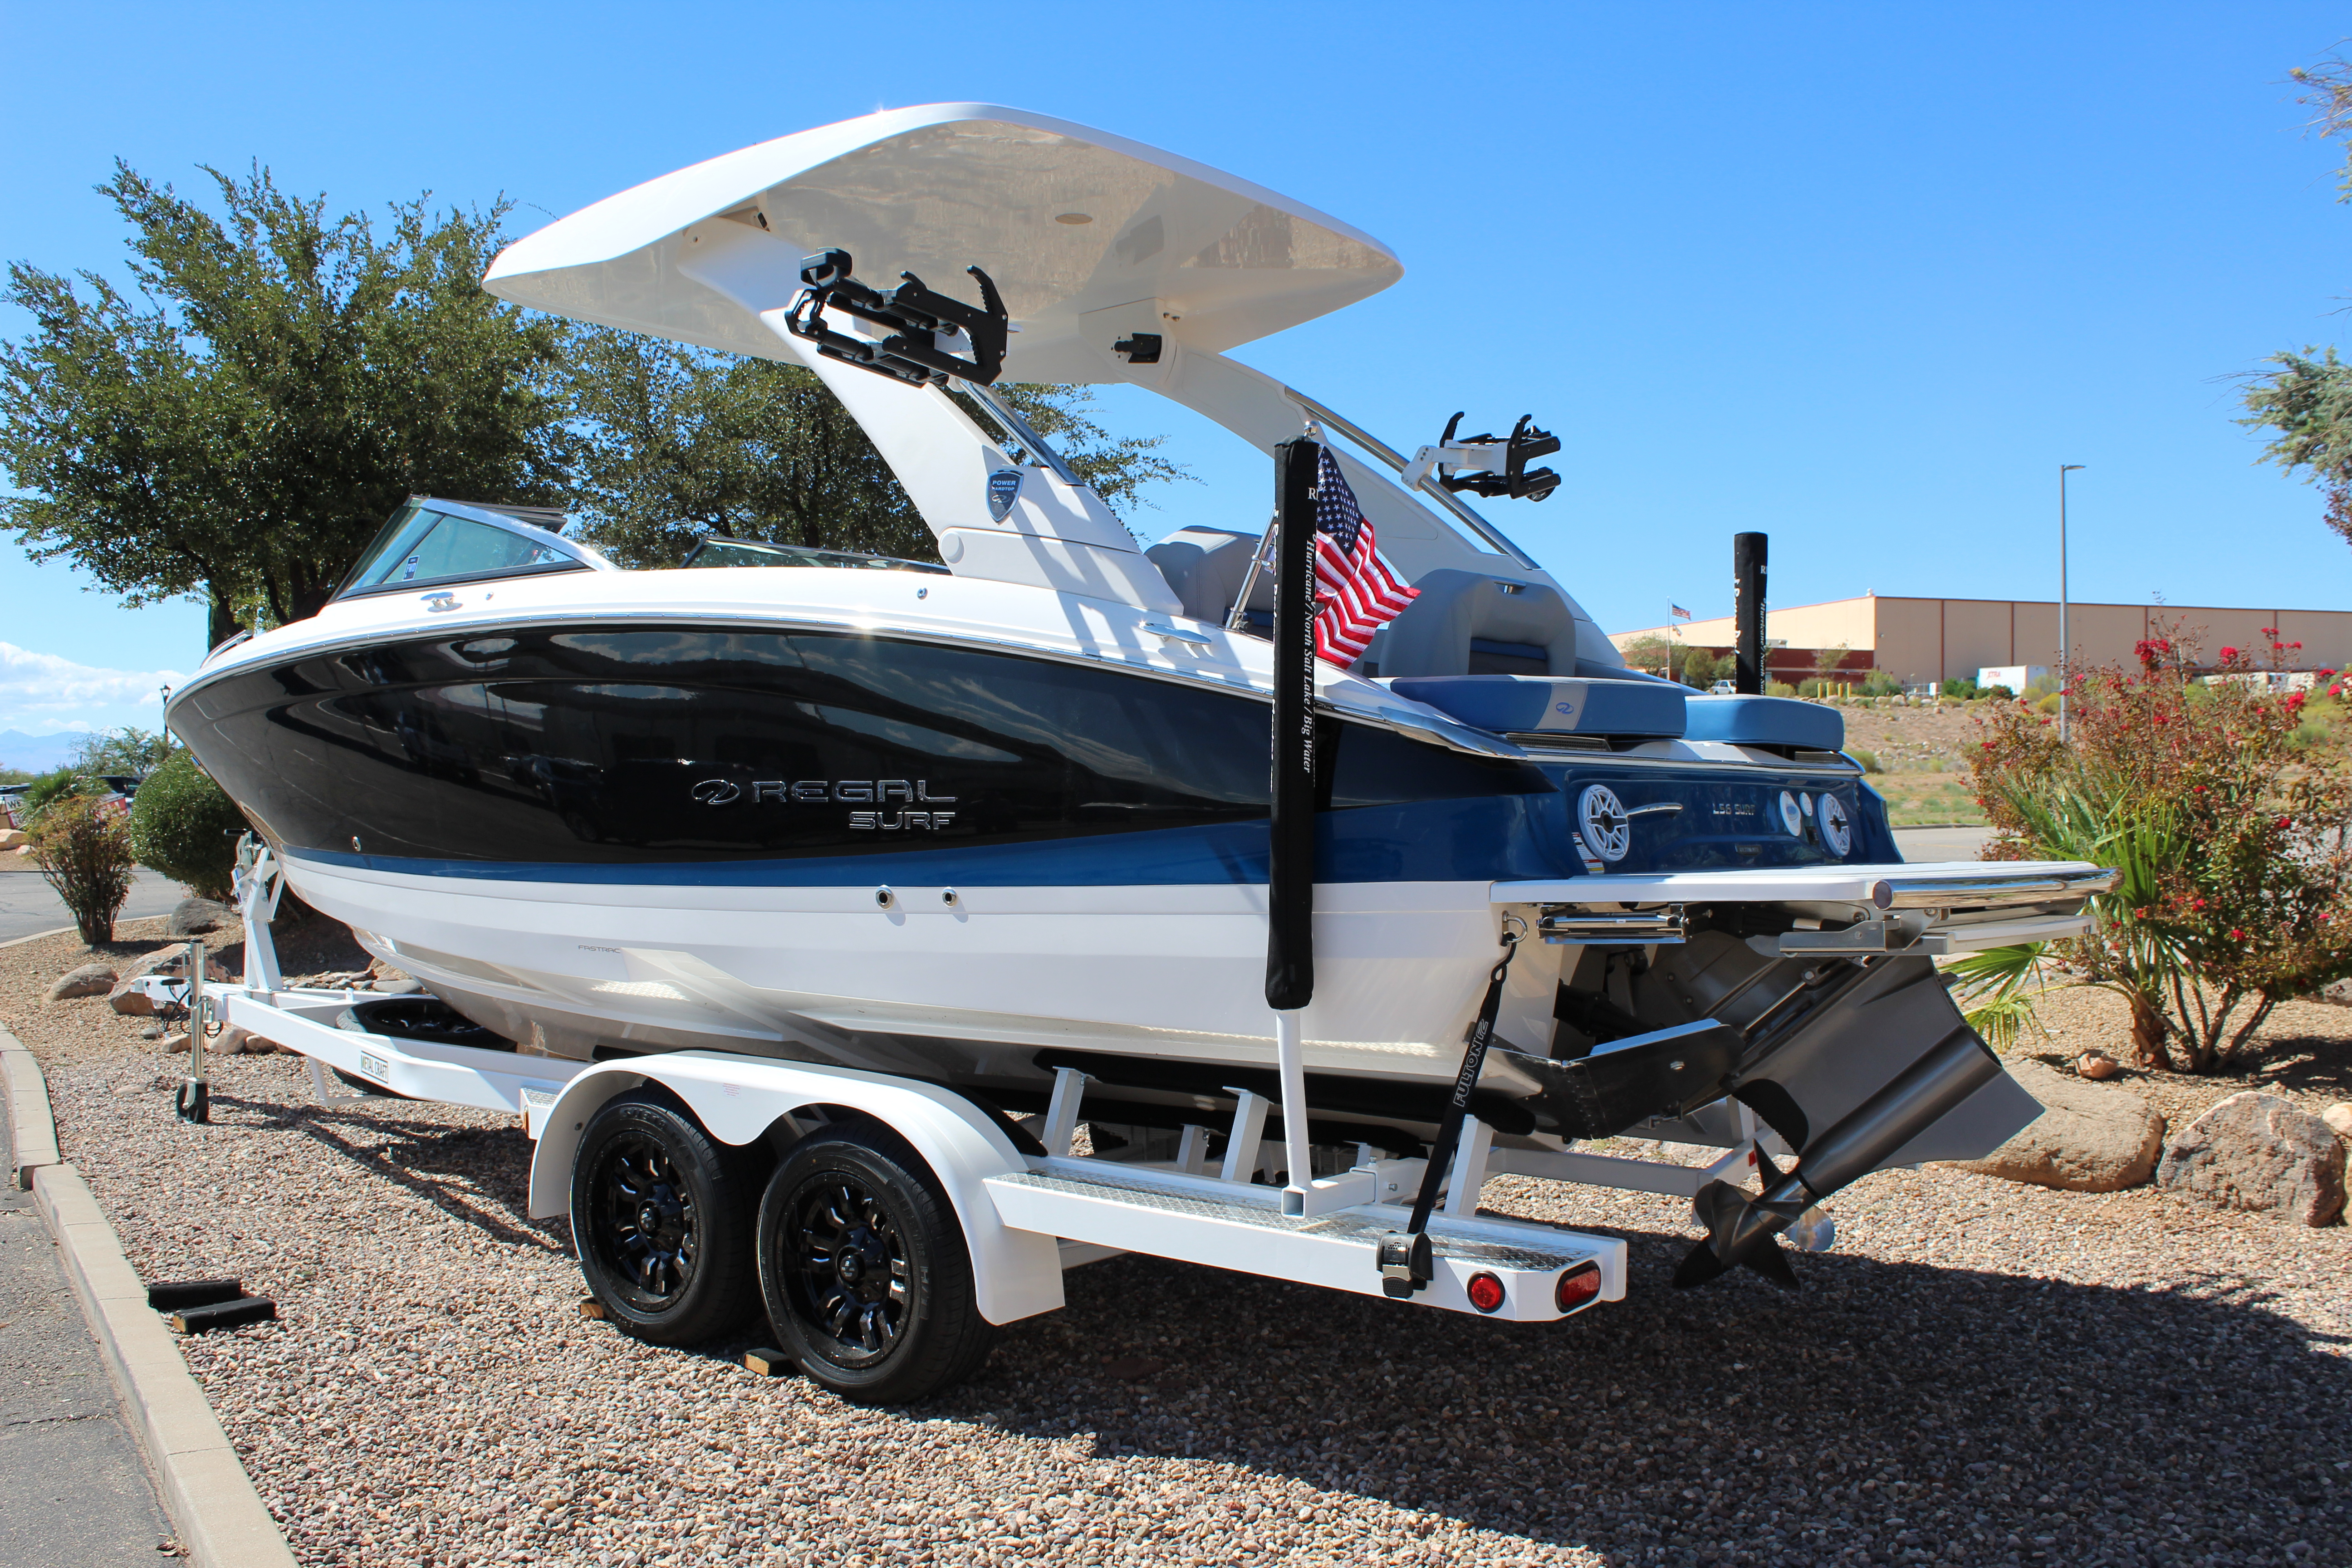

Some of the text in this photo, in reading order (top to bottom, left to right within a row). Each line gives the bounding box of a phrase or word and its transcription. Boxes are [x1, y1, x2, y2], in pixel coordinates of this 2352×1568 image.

[1305, 539, 1314, 602] Hurricane
[1304, 611, 1313, 646] North
[1303, 649, 1313, 672] Salt
[1303, 674, 1313, 705] Lake
[1301, 714, 1312, 736] Big
[1303, 740, 1312, 773] Water
[752, 779, 958, 803] REGAL
[849, 812, 956, 830] SURF
[1734, 804, 1755, 815] SURF
[578, 945, 621, 954] FASTRAC
[361, 1054, 387, 1079] METAL CRAFT
[1453, 1039, 1483, 1107] FULTON
